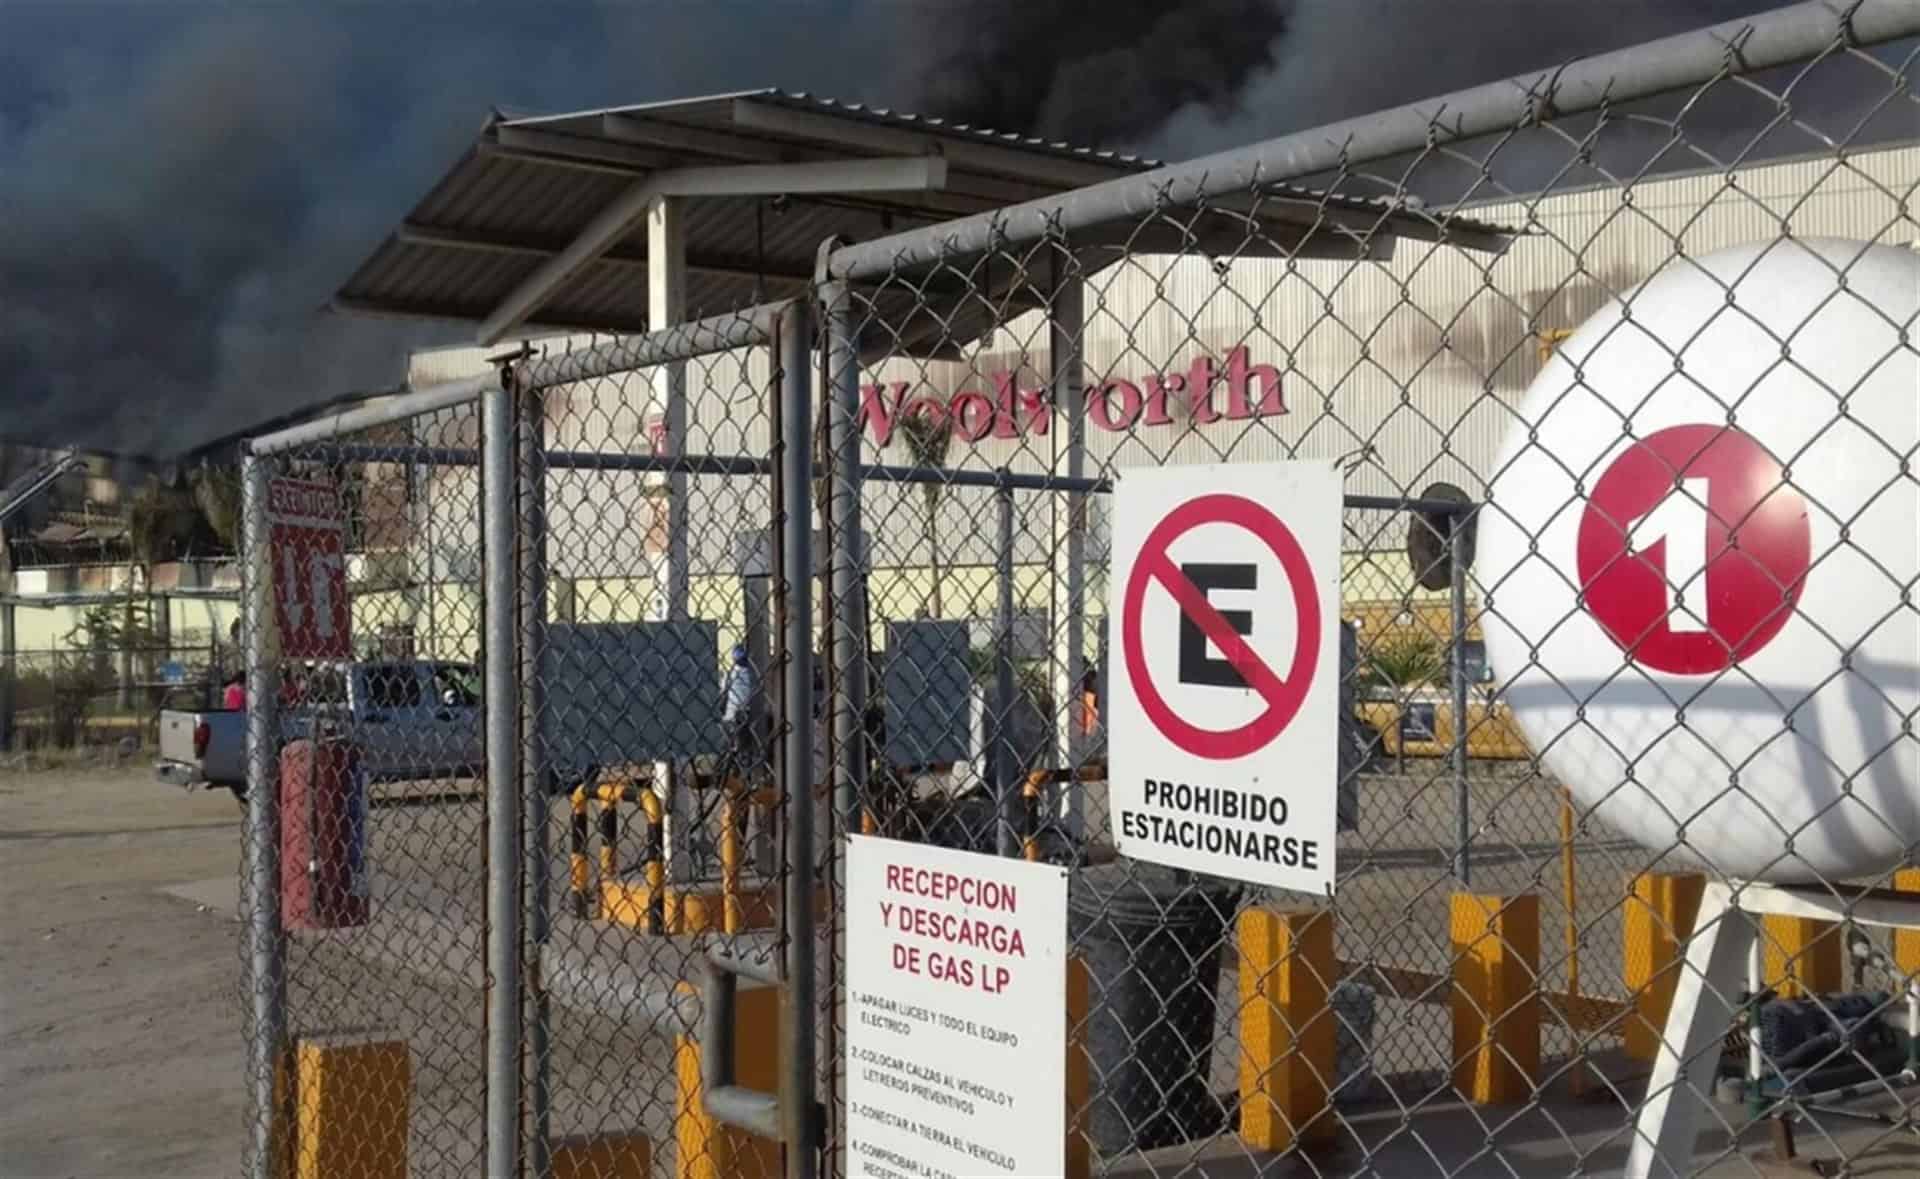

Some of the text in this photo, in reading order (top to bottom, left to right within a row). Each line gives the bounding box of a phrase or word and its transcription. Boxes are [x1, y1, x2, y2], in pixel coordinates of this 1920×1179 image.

[1625, 477, 1710, 633] 1
[1178, 563, 1257, 688] E
[1143, 778, 1288, 826] PROHIBIDO
[1121, 810, 1318, 870] ESTACIONARSE
[886, 864, 1016, 914] RECEPCION
[879, 901, 1025, 958] Y DESCARGA
[893, 943, 1011, 995] DE GAS LP
[860, 1010, 911, 1036] ELECTRICO
[899, 1003, 929, 1023] LUCES
[930, 1011, 937, 1025] Y
[938, 1013, 965, 1033] TODO
[967, 1021, 979, 1037] EL
[980, 1025, 1019, 1048] EQUIPO
[863, 1067, 976, 1116] LETREROS PREVENTIVOS
[906, 1061, 942, 1085] CALZAS
[943, 1074, 955, 1090] AL
[956, 1079, 1006, 1106] VEHICULO
[1006, 1095, 1014, 1109] Y
[910, 1121, 918, 1135] A
[918, 1123, 953, 1148] TIERRA
[953, 1136, 966, 1153] EL
[966, 1141, 1017, 1172] VEHICULO
[919, 1162, 932, 1179] LA
